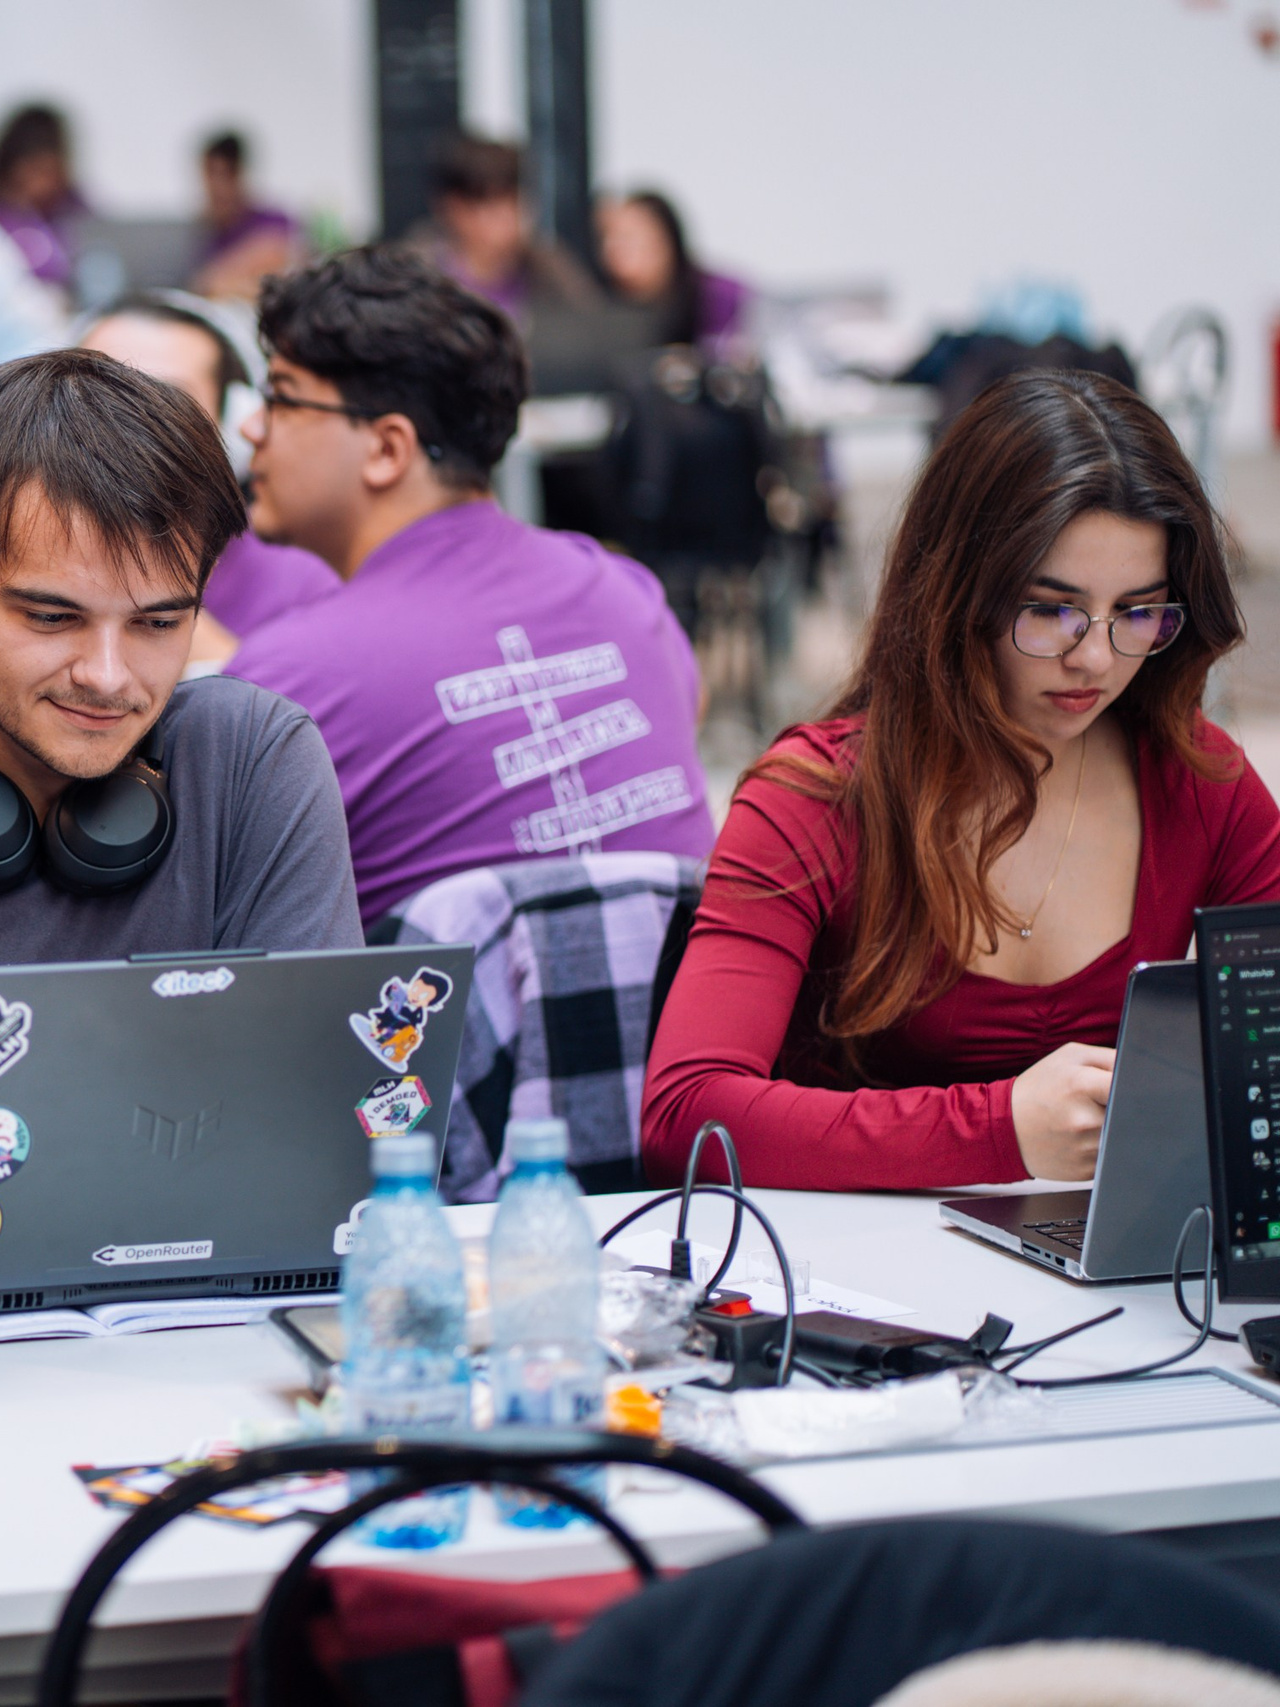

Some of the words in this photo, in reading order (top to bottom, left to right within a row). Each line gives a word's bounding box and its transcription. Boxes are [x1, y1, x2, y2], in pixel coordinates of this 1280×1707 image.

[138, 762, 162, 778] SONY
[373, 1081, 396, 1097] MLH
[373, 1091, 418, 1114] DEMOED
[125, 1244, 211, 1260] OpenRouter
